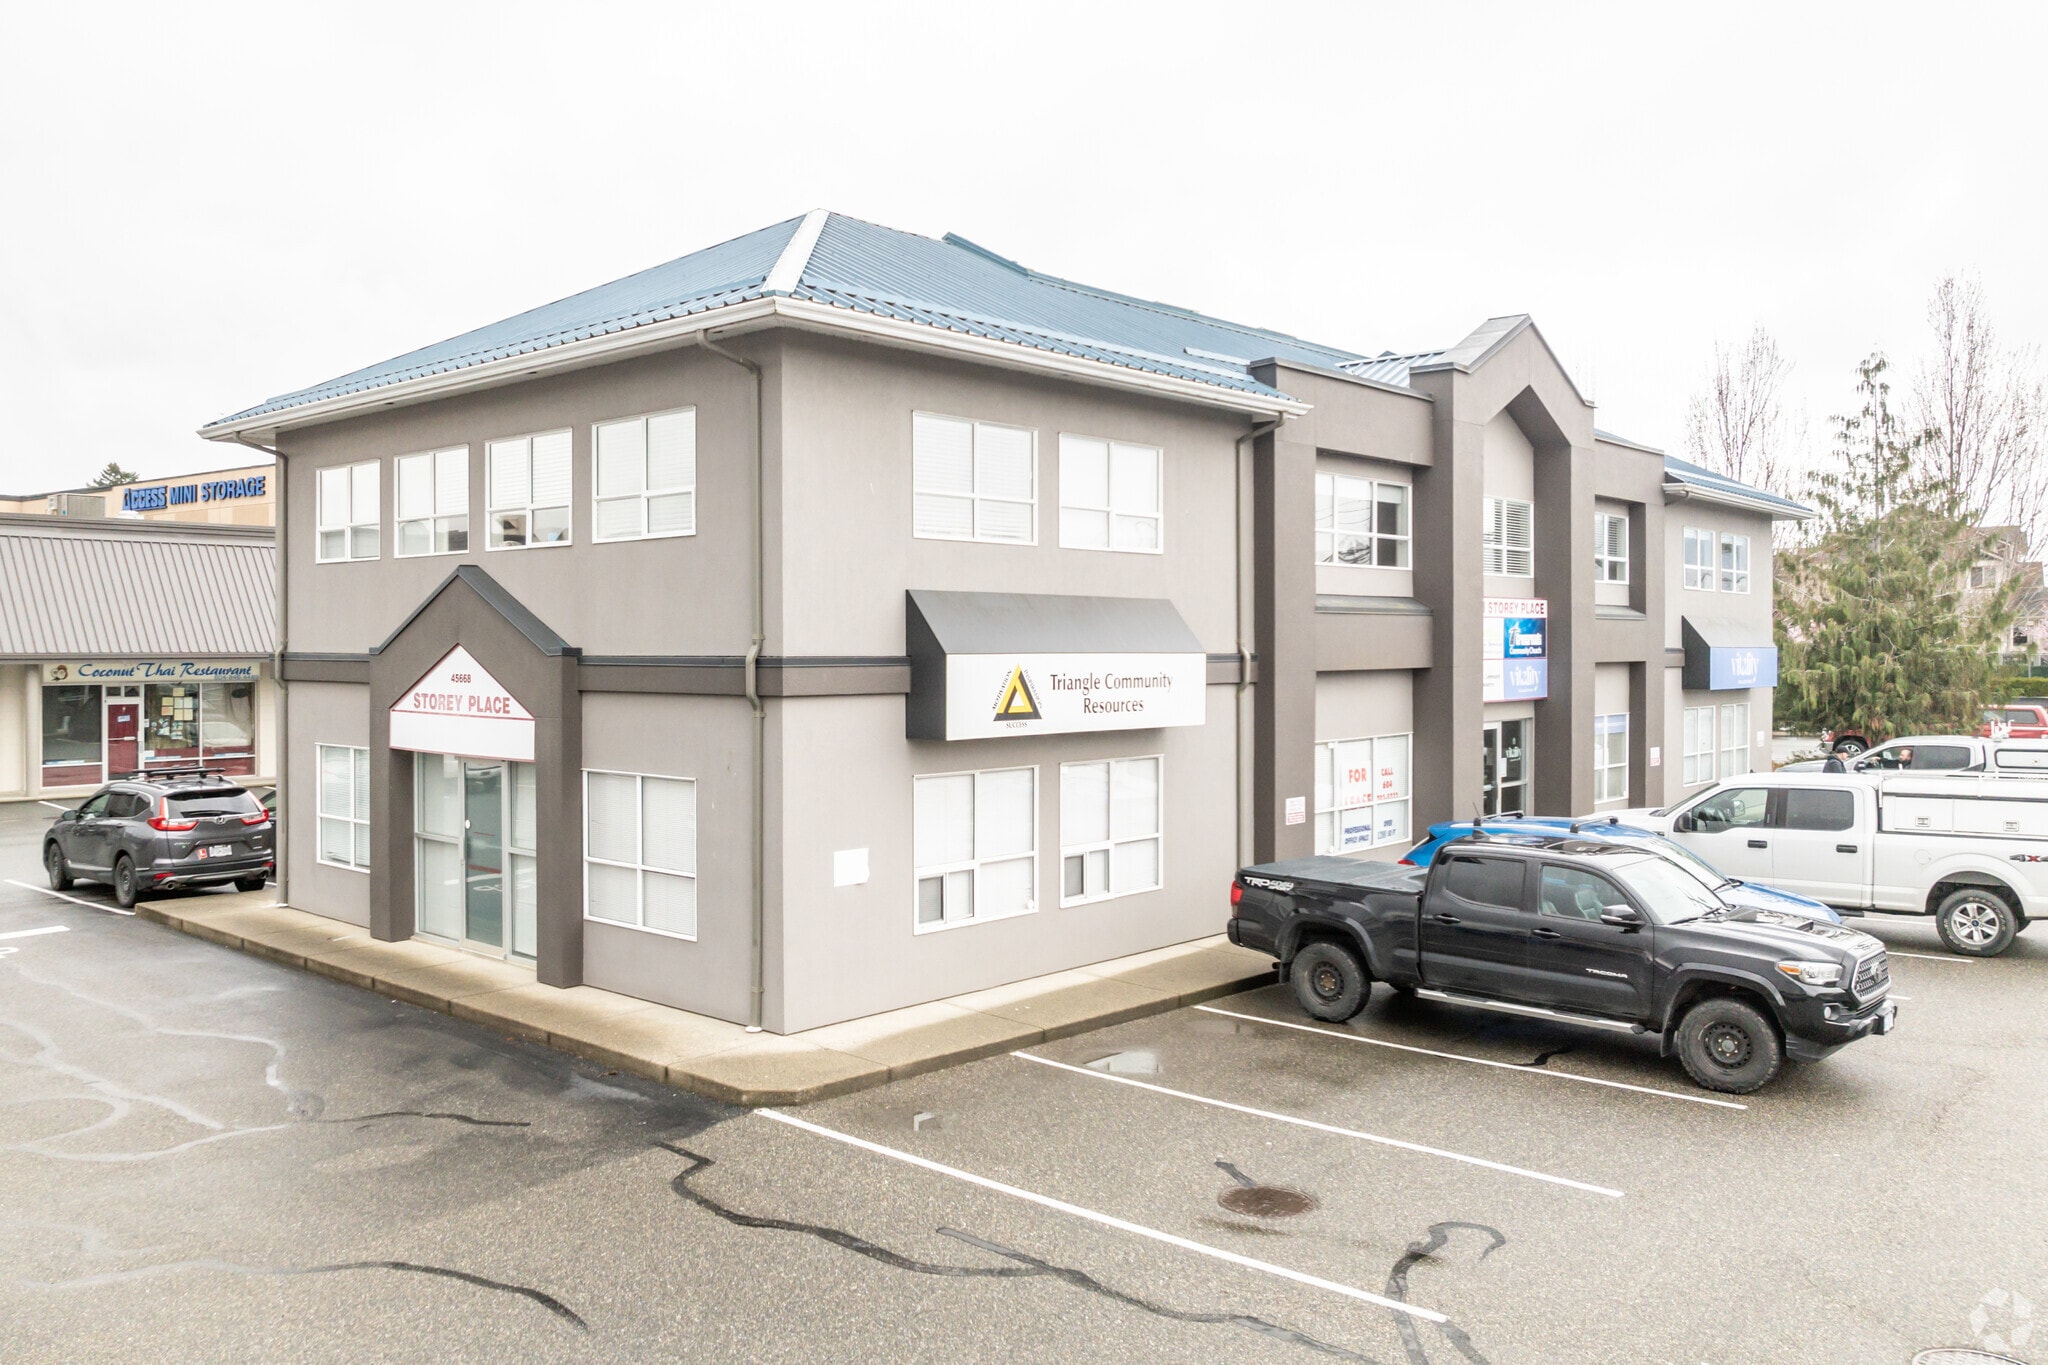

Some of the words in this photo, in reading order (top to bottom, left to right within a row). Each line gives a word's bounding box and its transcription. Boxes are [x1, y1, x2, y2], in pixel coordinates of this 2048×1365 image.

[122, 485, 168, 511] ACCESS
[169, 484, 198, 505] MINI
[201, 475, 266, 502] STORAGE
[1488, 602, 1519, 614] STOREY
[1521, 602, 1545, 614] PLACE
[78, 663, 135, 677] Coconut
[136, 662, 175, 677] Thai
[179, 662, 252, 678] Restaurant
[450, 673, 472, 683] 45668
[1050, 672, 1100, 696] Triangle
[1104, 671, 1173, 693] Community
[413, 692, 463, 711] STOREY
[468, 695, 511, 714] PLACE
[1083, 697, 1144, 714] Resources
[1348, 768, 1367, 783] FOR
[1381, 767, 1394, 776] CALL
[1244, 876, 1270, 888] TRD
[1585, 967, 1628, 979] TACOMA
